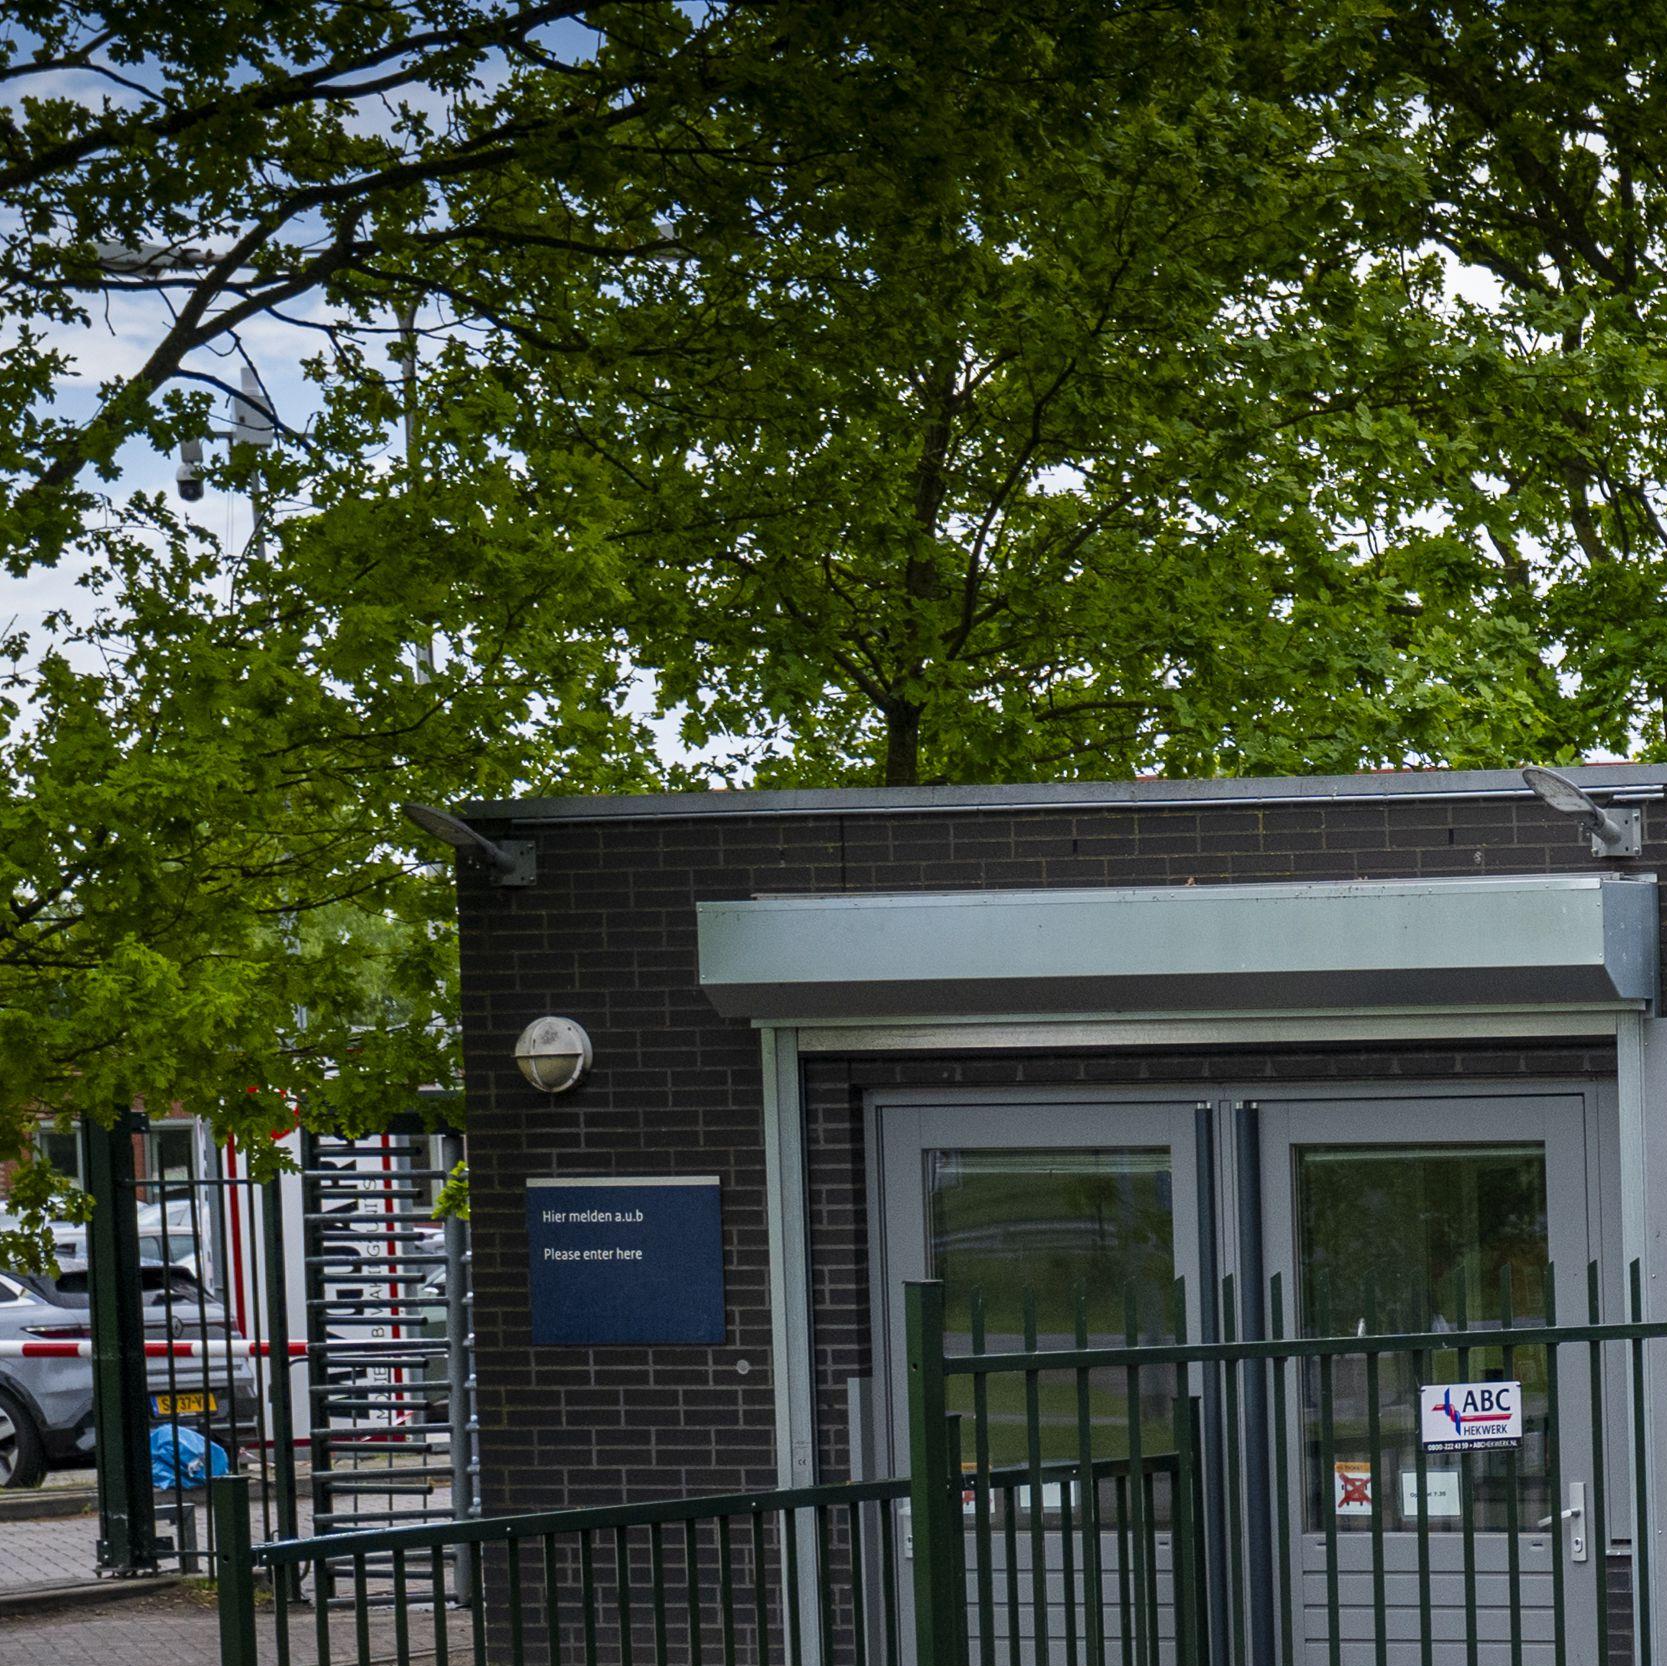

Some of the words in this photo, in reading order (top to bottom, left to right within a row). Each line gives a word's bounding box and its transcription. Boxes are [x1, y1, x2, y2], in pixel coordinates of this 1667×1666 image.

[542, 1210, 567, 1222] Hier
[569, 1209, 612, 1222] melden
[615, 1209, 643, 1222] a.u.b
[544, 1247, 581, 1260] Please
[583, 1249, 614, 1260] enter
[616, 1247, 643, 1260] here
[1462, 1388, 1511, 1413] ABC
[1463, 1424, 1508, 1436] HEKWERK
